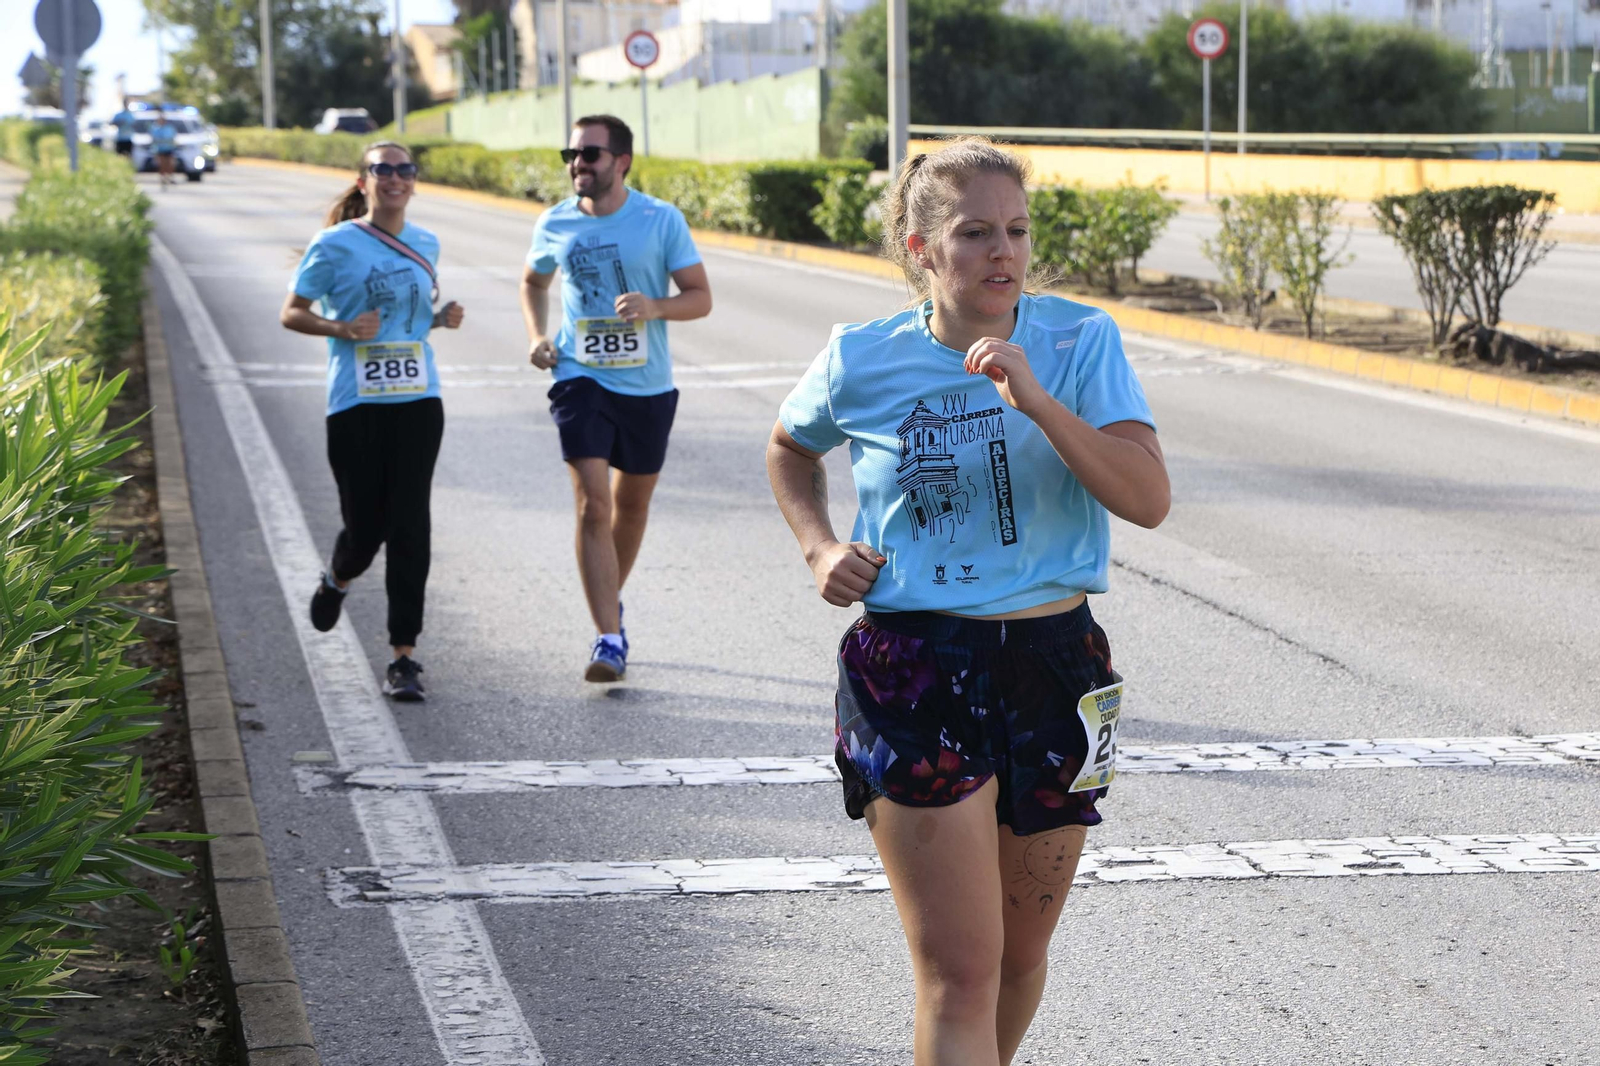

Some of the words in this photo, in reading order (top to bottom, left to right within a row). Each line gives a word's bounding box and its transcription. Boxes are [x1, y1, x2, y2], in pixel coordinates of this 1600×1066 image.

[1198, 30, 1219, 46] 50
[584, 333, 638, 354] 285
[364, 359, 419, 381] 286
[941, 392, 967, 416] XXV
[951, 406, 1004, 423] CARRERA
[949, 415, 1005, 446] URBANA
[981, 443, 995, 512] CIUDAD
[990, 519, 998, 543] DE
[992, 443, 1014, 542] ALGECIRAS
[949, 475, 978, 544] 2025
